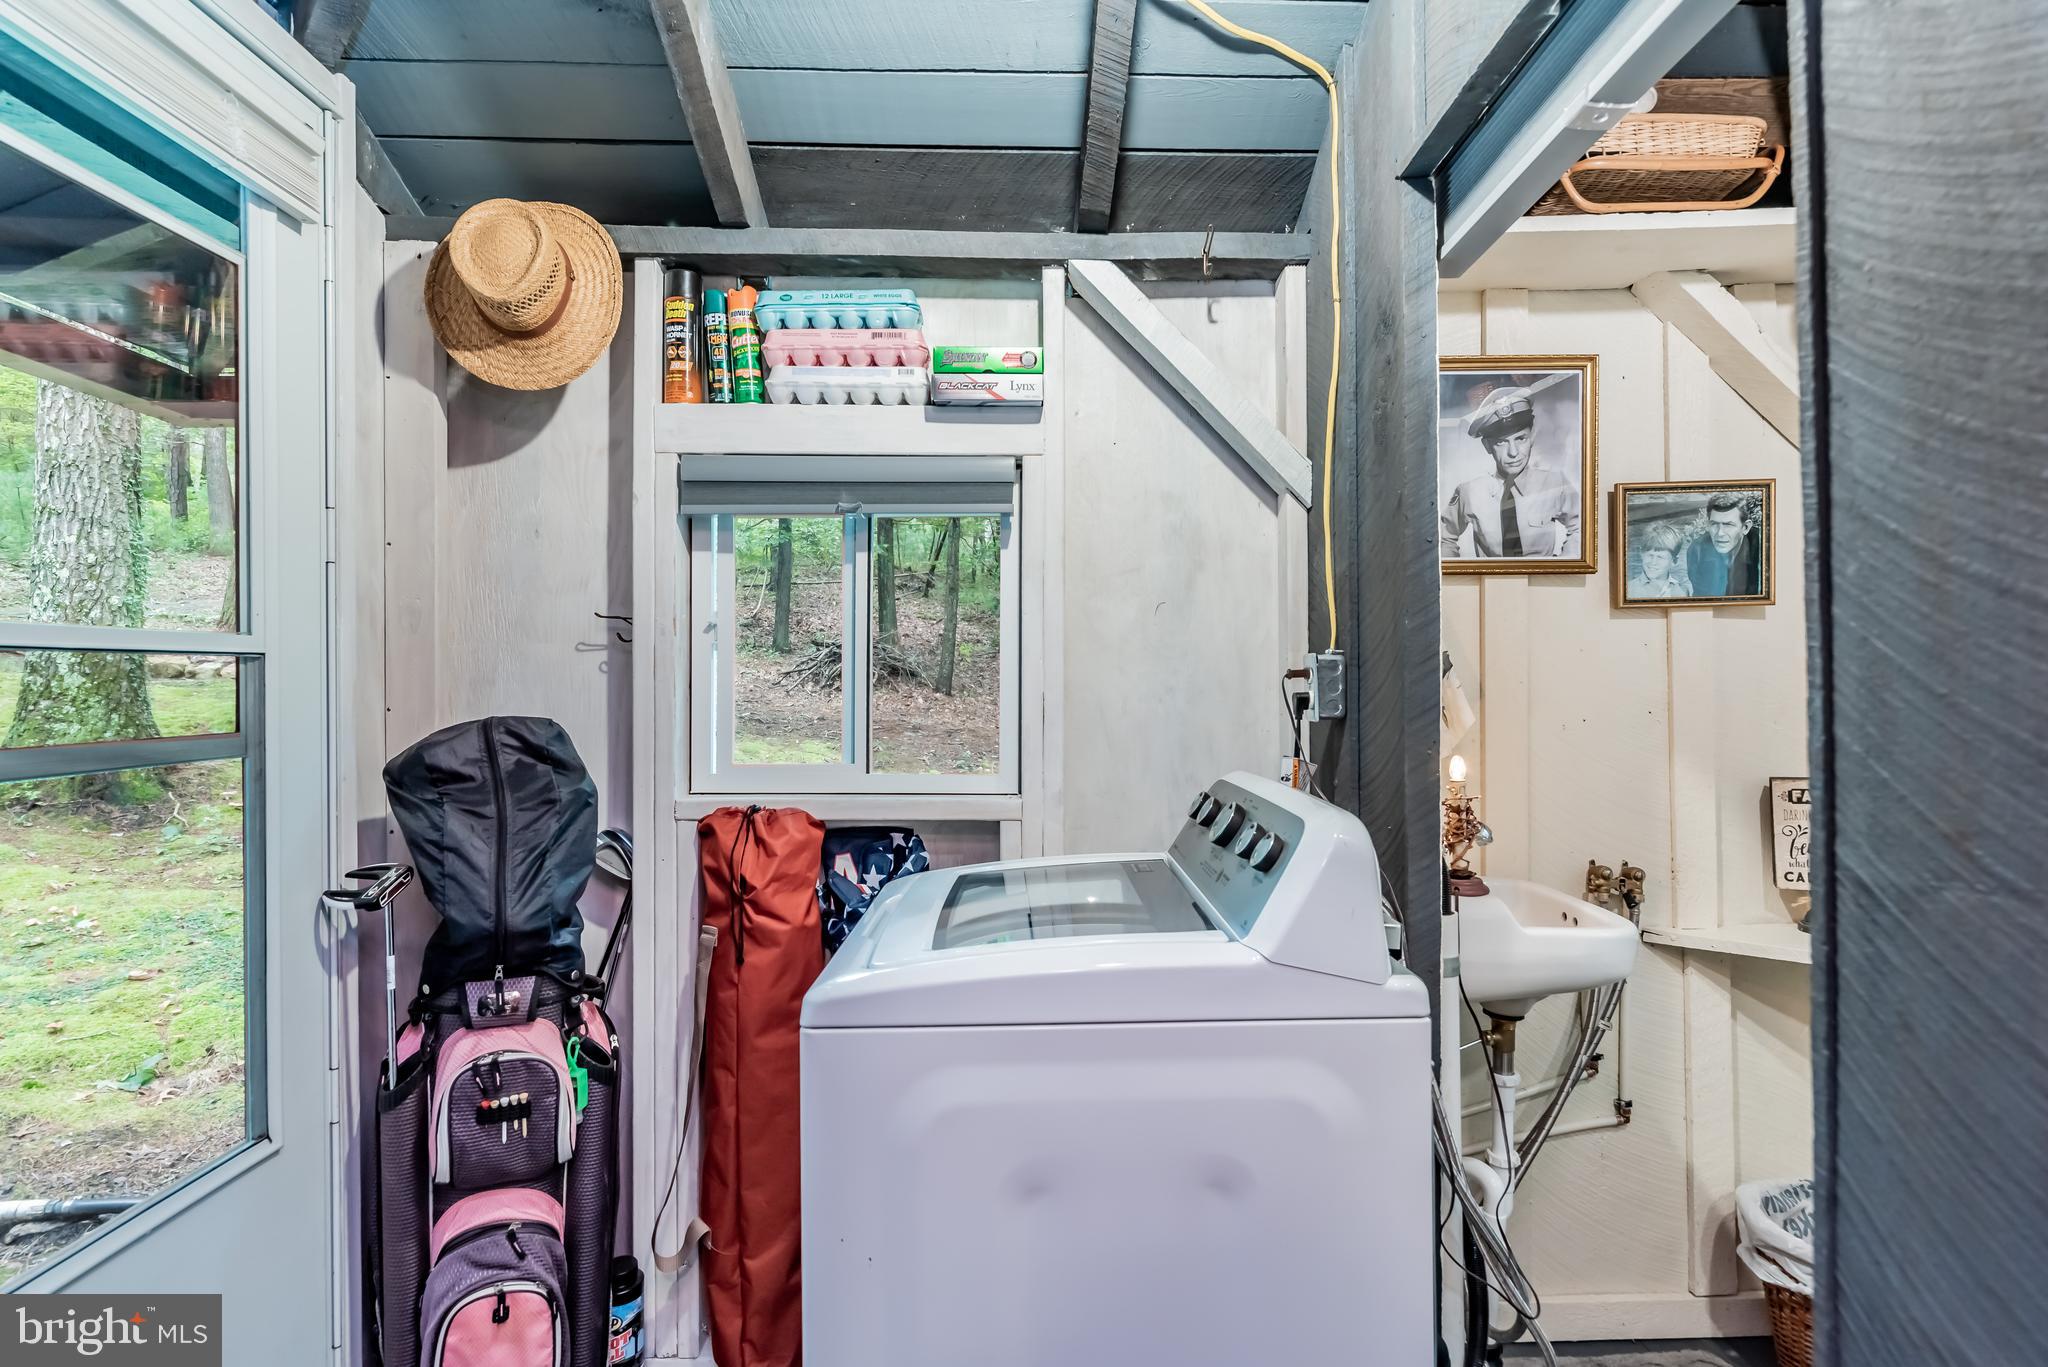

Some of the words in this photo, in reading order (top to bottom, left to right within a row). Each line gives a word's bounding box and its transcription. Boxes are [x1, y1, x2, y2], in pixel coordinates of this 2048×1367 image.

[666, 300, 695, 311] Sudden
[709, 334, 728, 345] MAX
[714, 348, 725, 356] 40
[1010, 380, 1035, 393] Lynx
[1792, 790, 1812, 802] FA
[1784, 809, 1808, 821] DARIN
[1784, 871, 1806, 883] CA
